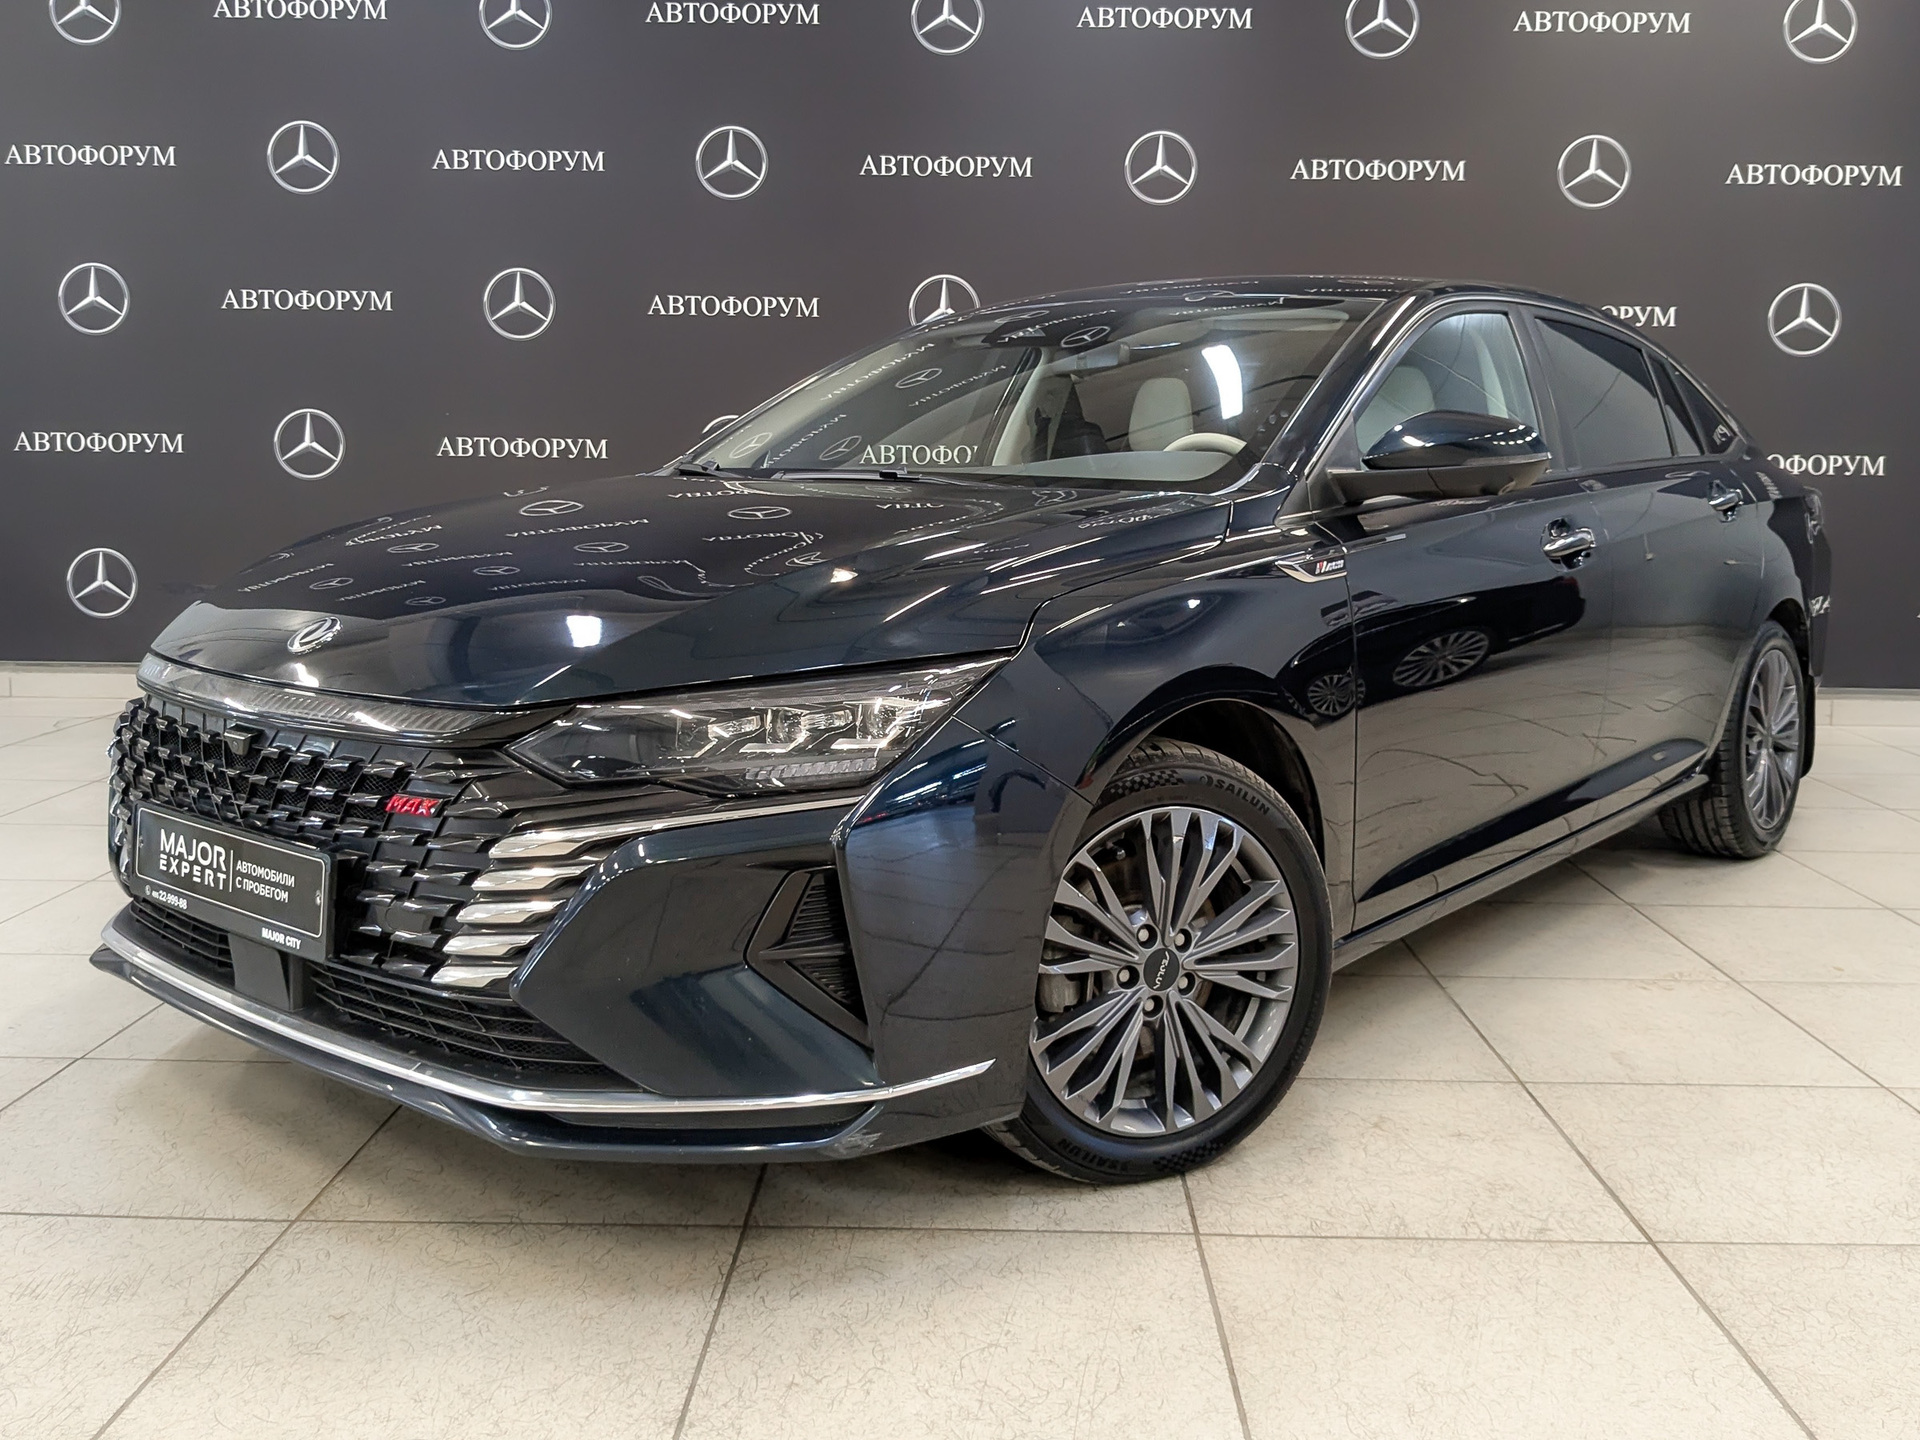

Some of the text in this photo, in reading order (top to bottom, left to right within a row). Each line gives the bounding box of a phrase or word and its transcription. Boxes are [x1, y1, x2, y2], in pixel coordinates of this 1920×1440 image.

[213, 0, 388, 19] АВТОФОРУМ
[645, 2, 821, 25] АВТОФОРУМ
[1077, 7, 1253, 29] АВТОФОРУМ
[1513, 11, 1692, 34] АВТОФОРУМ
[4, 145, 177, 167] АВТОФОРУМ
[432, 149, 606, 172] АВТОФОРУМ
[859, 155, 1033, 177] АВТОФОРУМ
[1290, 159, 1467, 182] АВТОФОРУМ
[1725, 164, 1903, 187] АВТОФОРУМ
[221, 289, 393, 311] АВТОФОРУМ
[647, 295, 820, 317] АВТОФОРУМ
[14, 432, 185, 454] АВТОФОРУМ
[437, 437, 609, 459] АВТОФОРУМ
[859, 444, 979, 465] АВТОФО
[385, 794, 439, 817] MAX
[1213, 778, 1271, 816] SAILUN
[160, 828, 227, 872] MAJOR
[160, 853, 227, 890] EXPERT
[236, 860, 296, 888] АВТОМОБИЛИ
[235, 876, 289, 904] С ПРОБЕГОМ
[261, 927, 302, 950] MAJOR CITY
